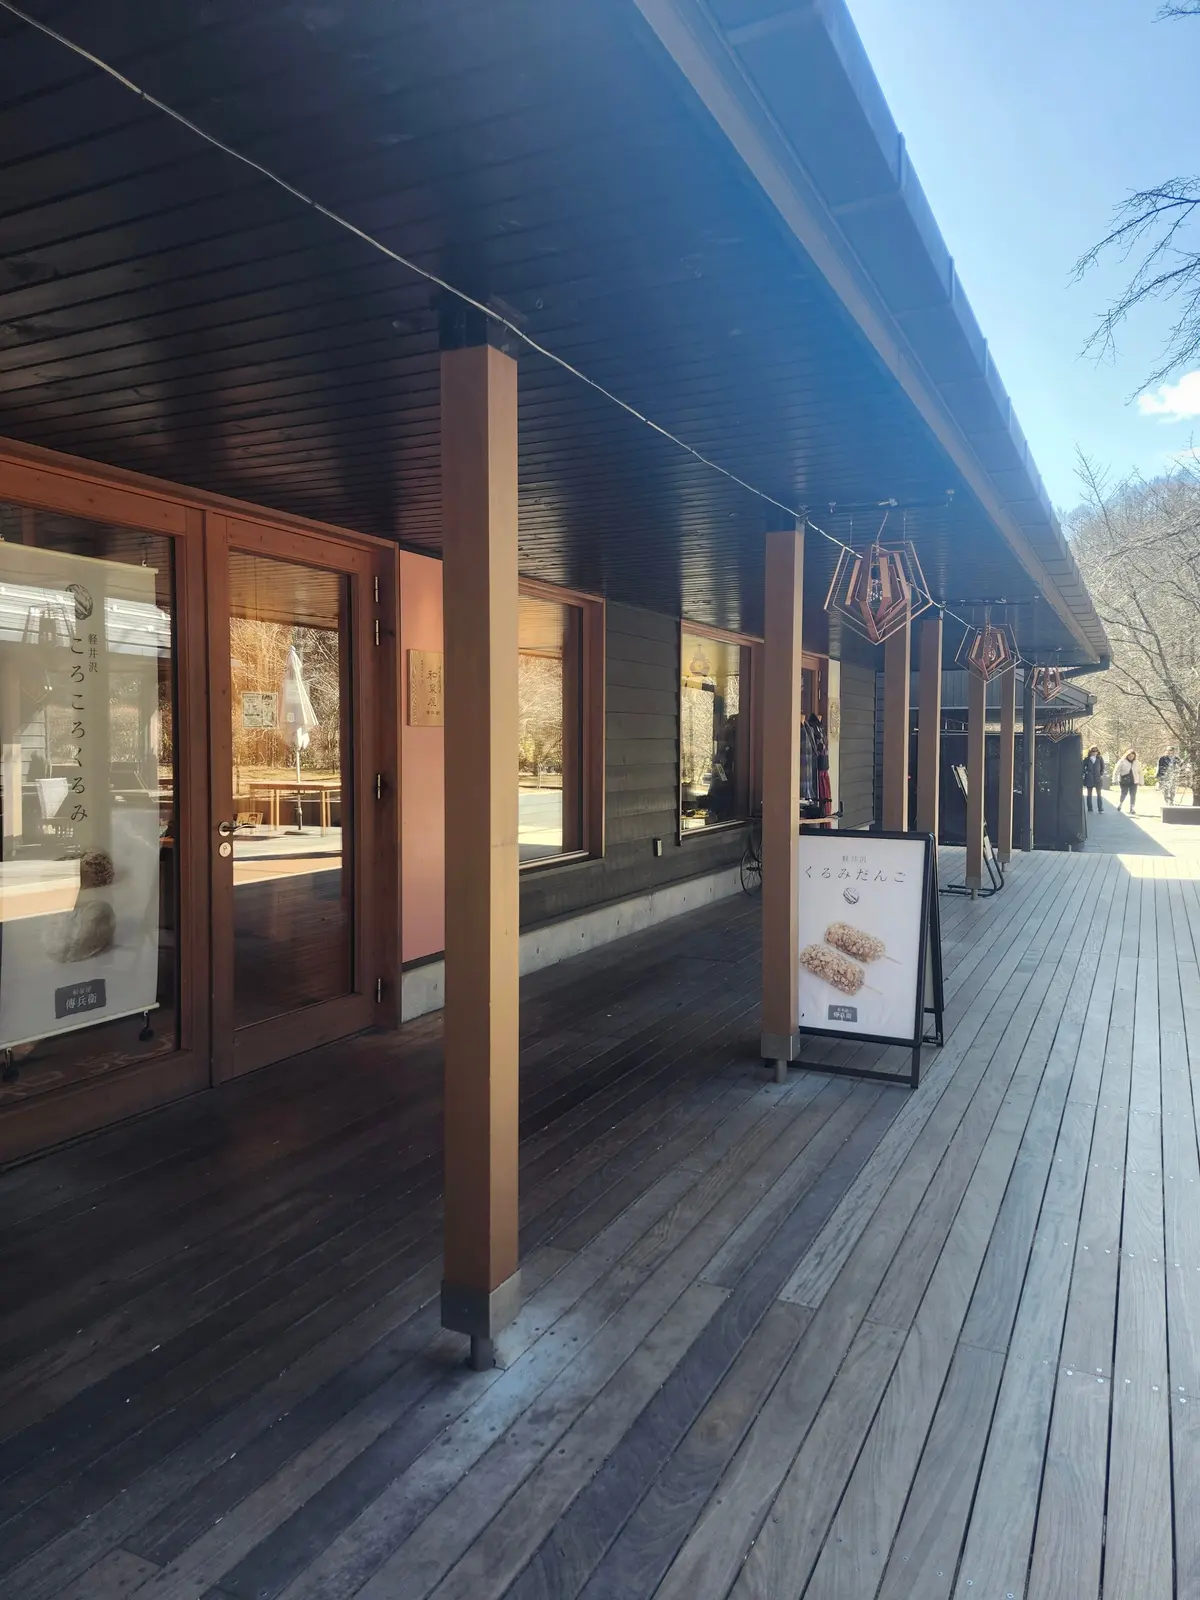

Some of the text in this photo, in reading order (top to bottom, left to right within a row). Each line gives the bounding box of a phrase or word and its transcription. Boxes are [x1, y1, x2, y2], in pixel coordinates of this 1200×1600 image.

[88, 633, 98, 673] 軽井沢
[70, 638, 87, 822] ころころくるみ
[805, 866, 906, 882] くるみだんご
